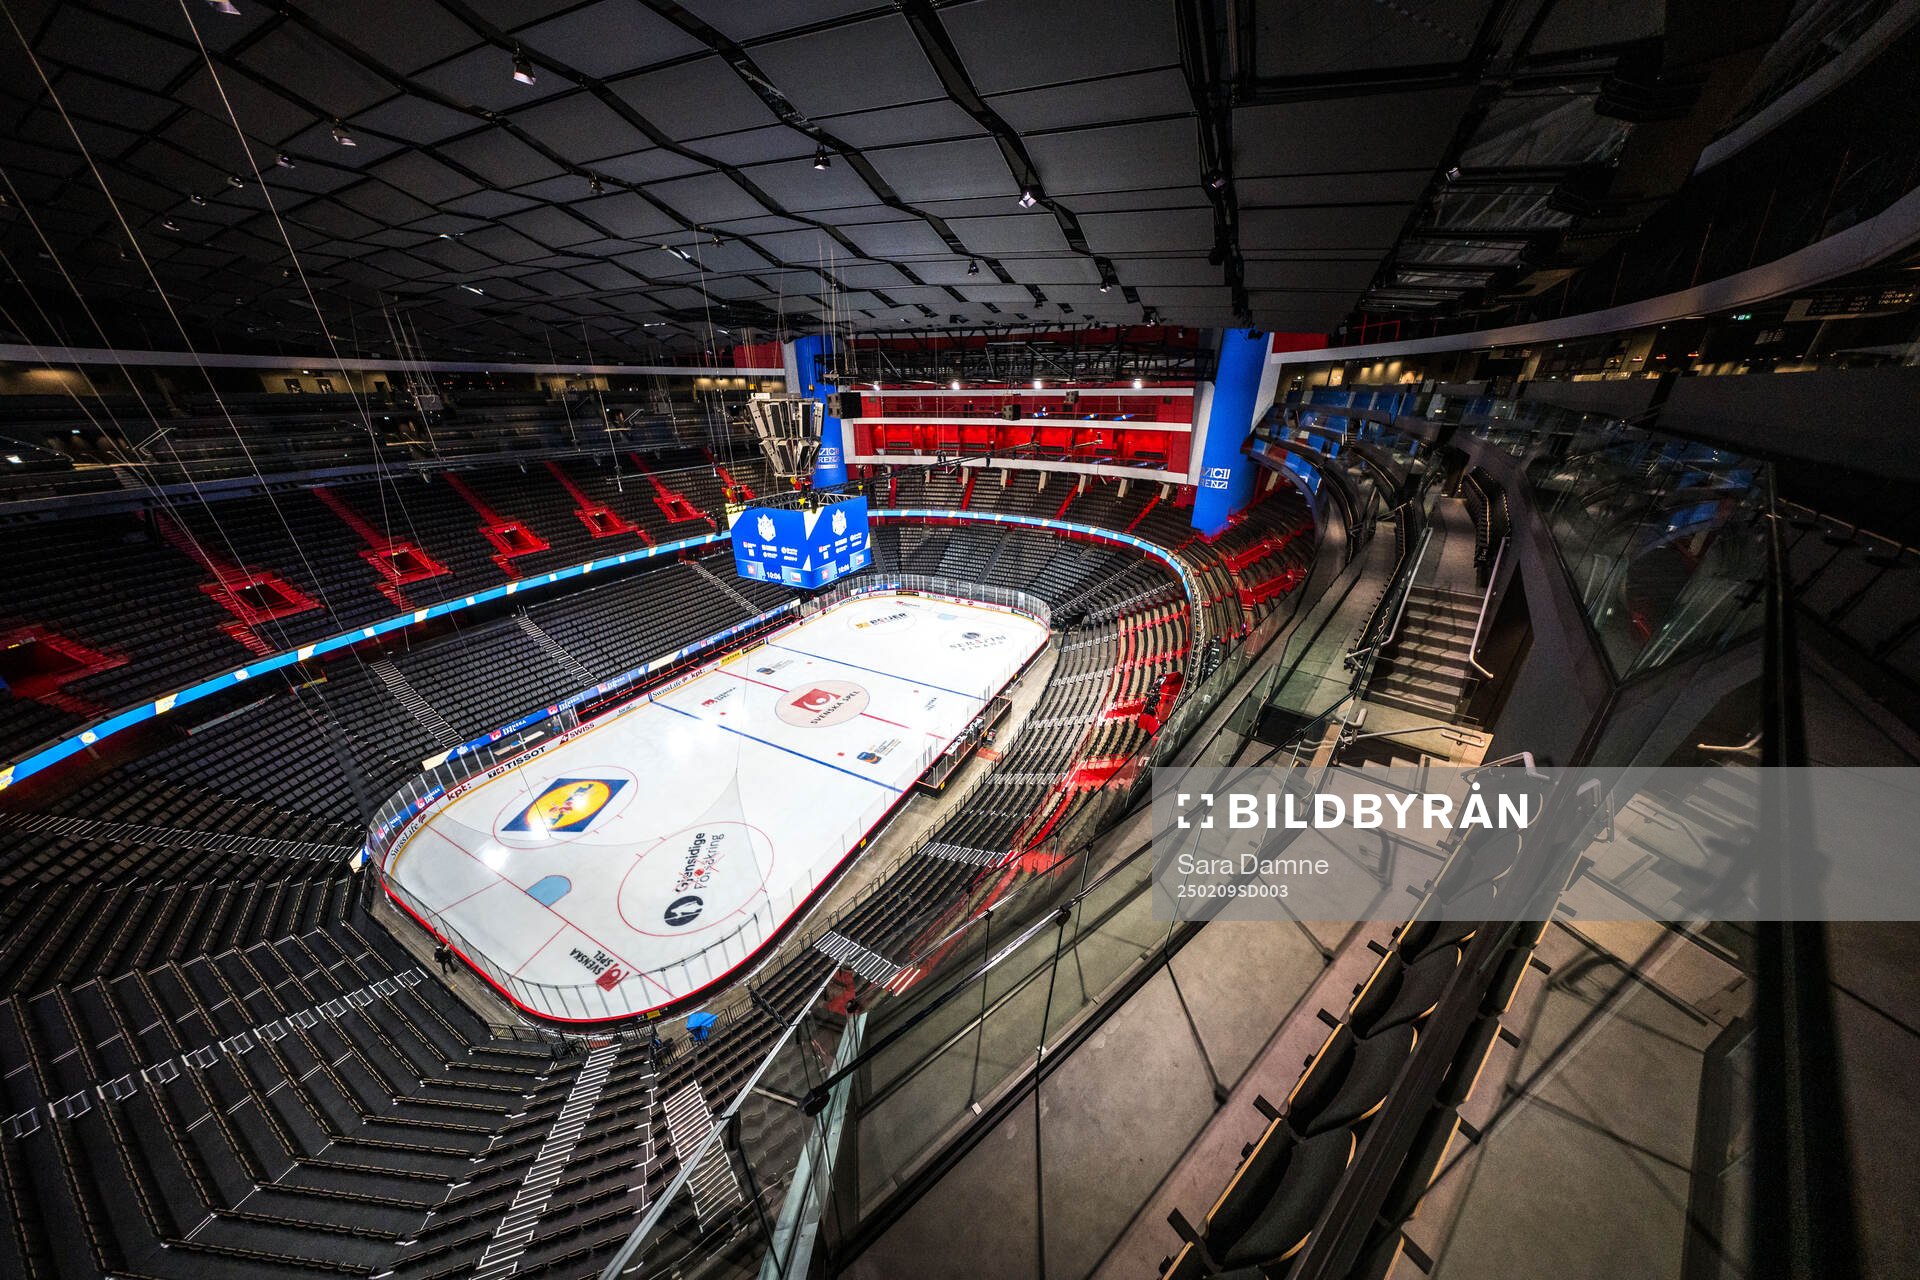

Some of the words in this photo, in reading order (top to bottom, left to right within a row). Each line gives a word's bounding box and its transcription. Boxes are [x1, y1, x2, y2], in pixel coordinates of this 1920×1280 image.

[810, 701, 844, 725] SVENSKA
[569, 722, 595, 738] SWISS
[505, 745, 546, 769] TISSOT
[446, 782, 472, 801] kpt:
[391, 822, 419, 859] SwissLife
[675, 832, 706, 893] Gjensidige
[569, 947, 604, 975] SVENSKA
[593, 950, 614, 967] SPEL
